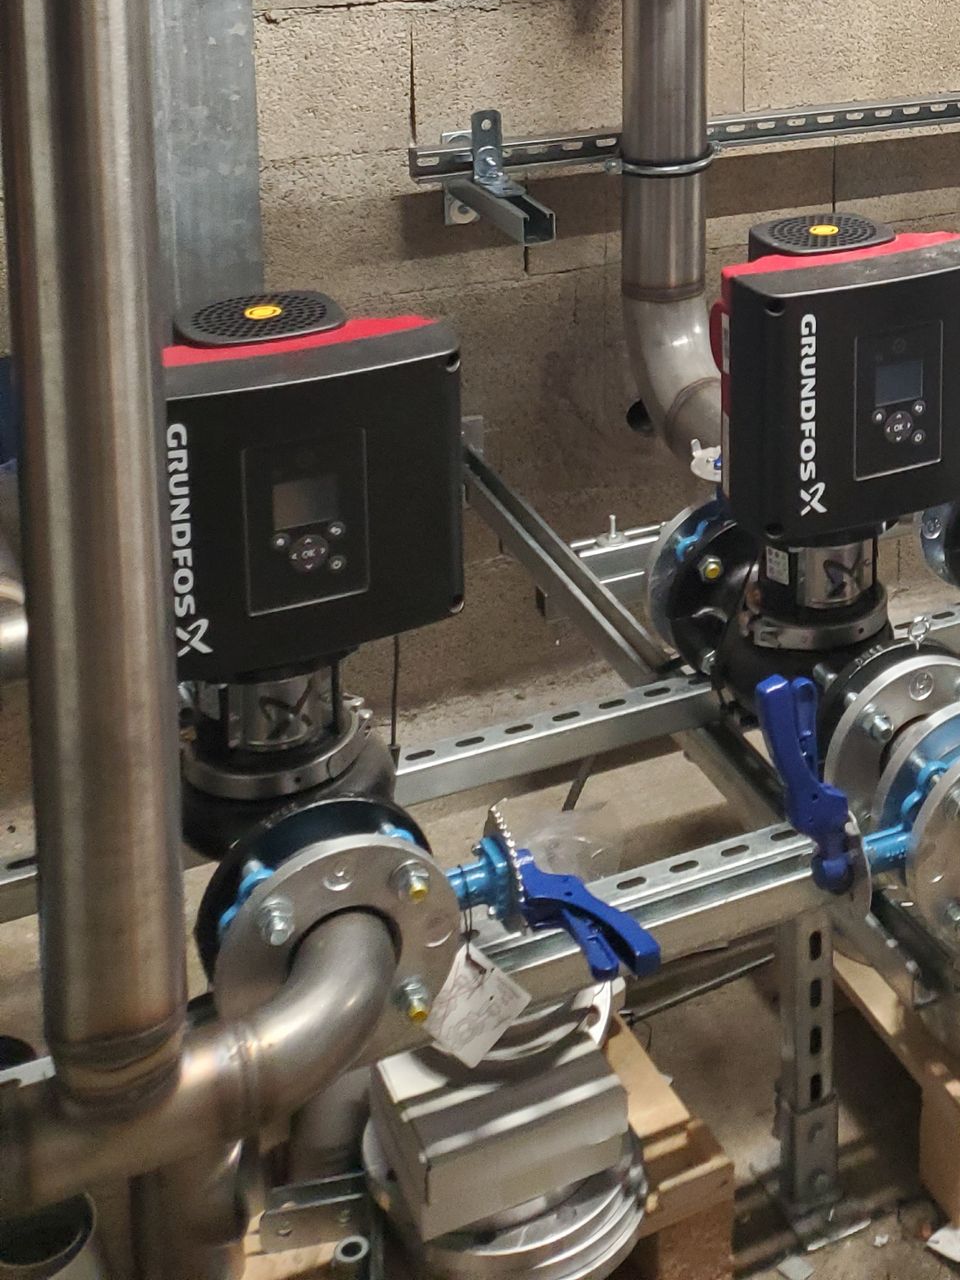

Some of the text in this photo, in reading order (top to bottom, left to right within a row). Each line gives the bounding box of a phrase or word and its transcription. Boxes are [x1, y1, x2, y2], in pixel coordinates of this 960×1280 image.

[800, 313, 817, 482] GRUNDFOS
[893, 423, 904, 432] OK
[166, 422, 196, 618] GRUNDFOS
[301, 549, 316, 559] OK
